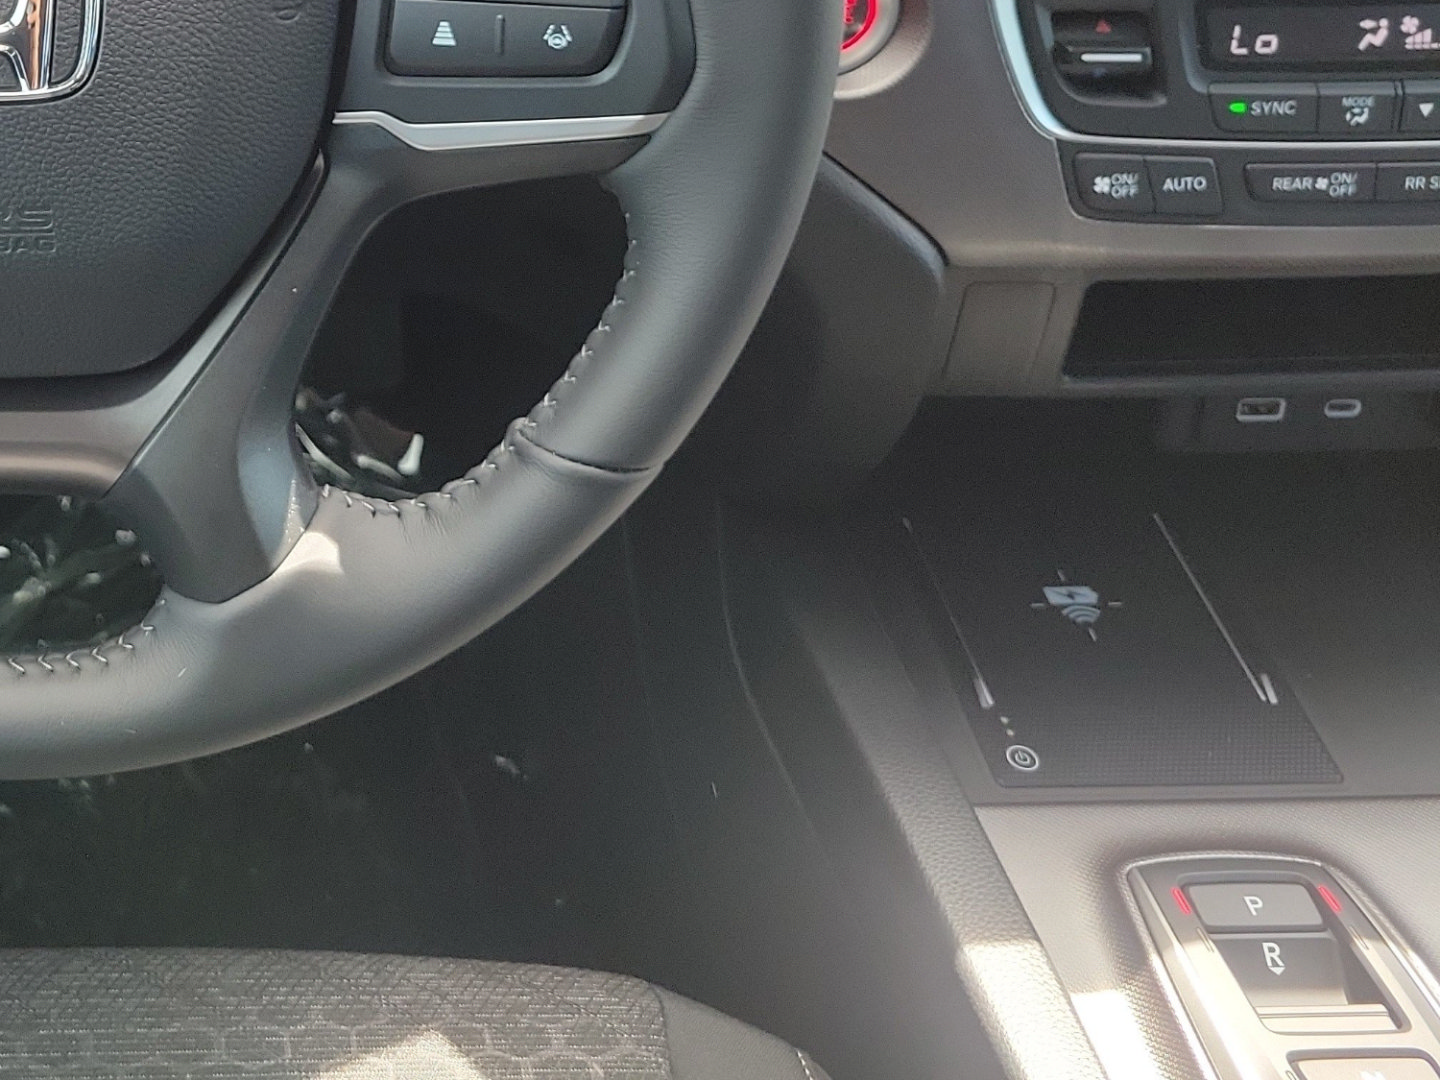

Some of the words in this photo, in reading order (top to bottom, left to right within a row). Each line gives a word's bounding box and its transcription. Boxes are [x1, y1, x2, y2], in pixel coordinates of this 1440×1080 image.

[1229, 24, 1279, 56] Lo
[1250, 99, 1298, 117] SYNC
[1341, 96, 1375, 109] MODE
[1111, 173, 1139, 187] ON/
[1162, 176, 1207, 192] AUTO
[1272, 176, 1313, 191] REAR
[1330, 171, 1358, 185] ON/
[1404, 175, 1427, 191] RR
[1110, 185, 1139, 200] OFF
[1329, 183, 1358, 197] OFF
[1243, 895, 1264, 917] P
[1261, 941, 1286, 968] R
